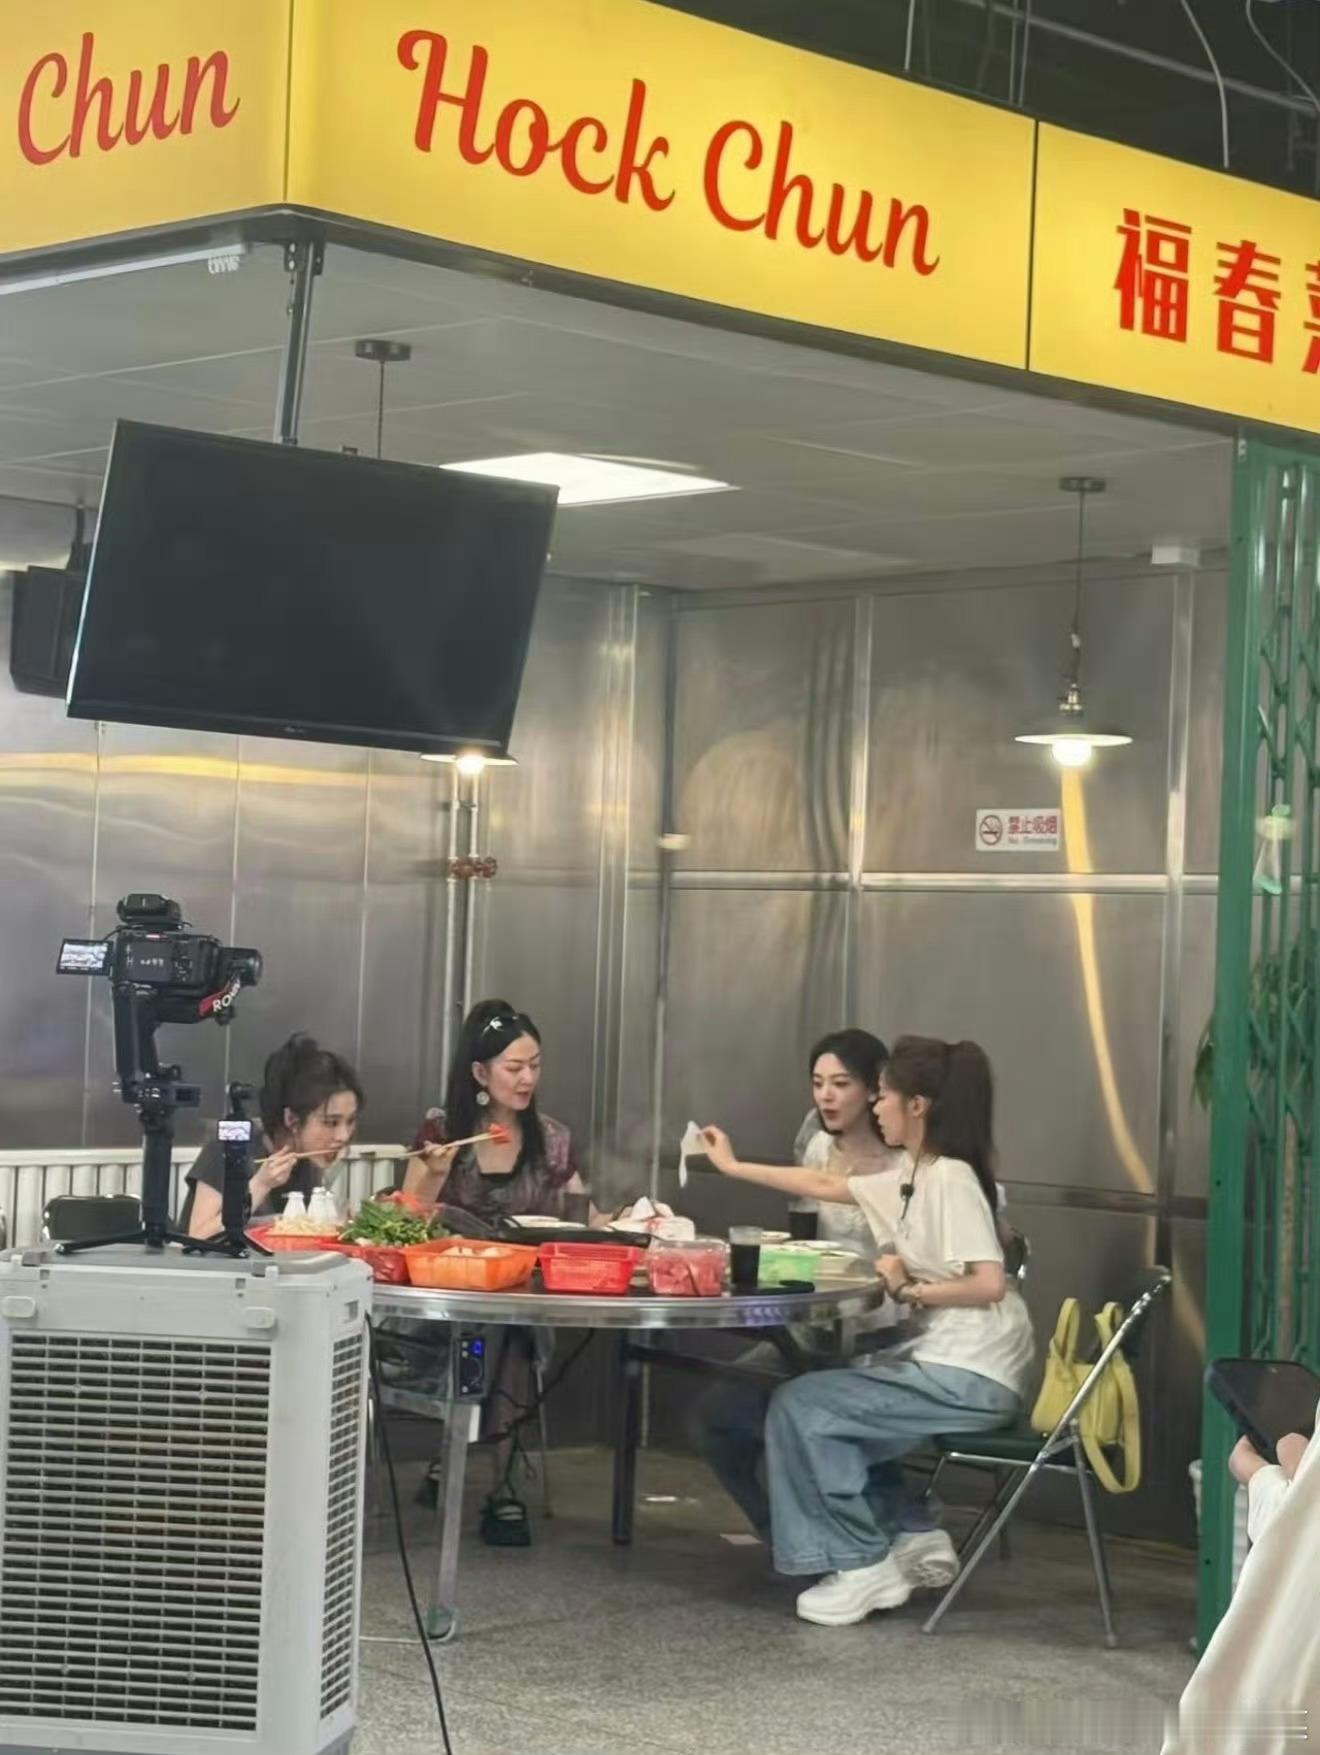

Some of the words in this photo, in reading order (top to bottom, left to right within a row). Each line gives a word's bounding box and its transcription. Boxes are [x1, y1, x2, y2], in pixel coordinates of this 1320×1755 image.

[18, 32, 240, 166] Chun
[396, 29, 673, 213] Hock
[703, 120, 938, 277] Chun
[1114, 208, 1320, 376] 福春
